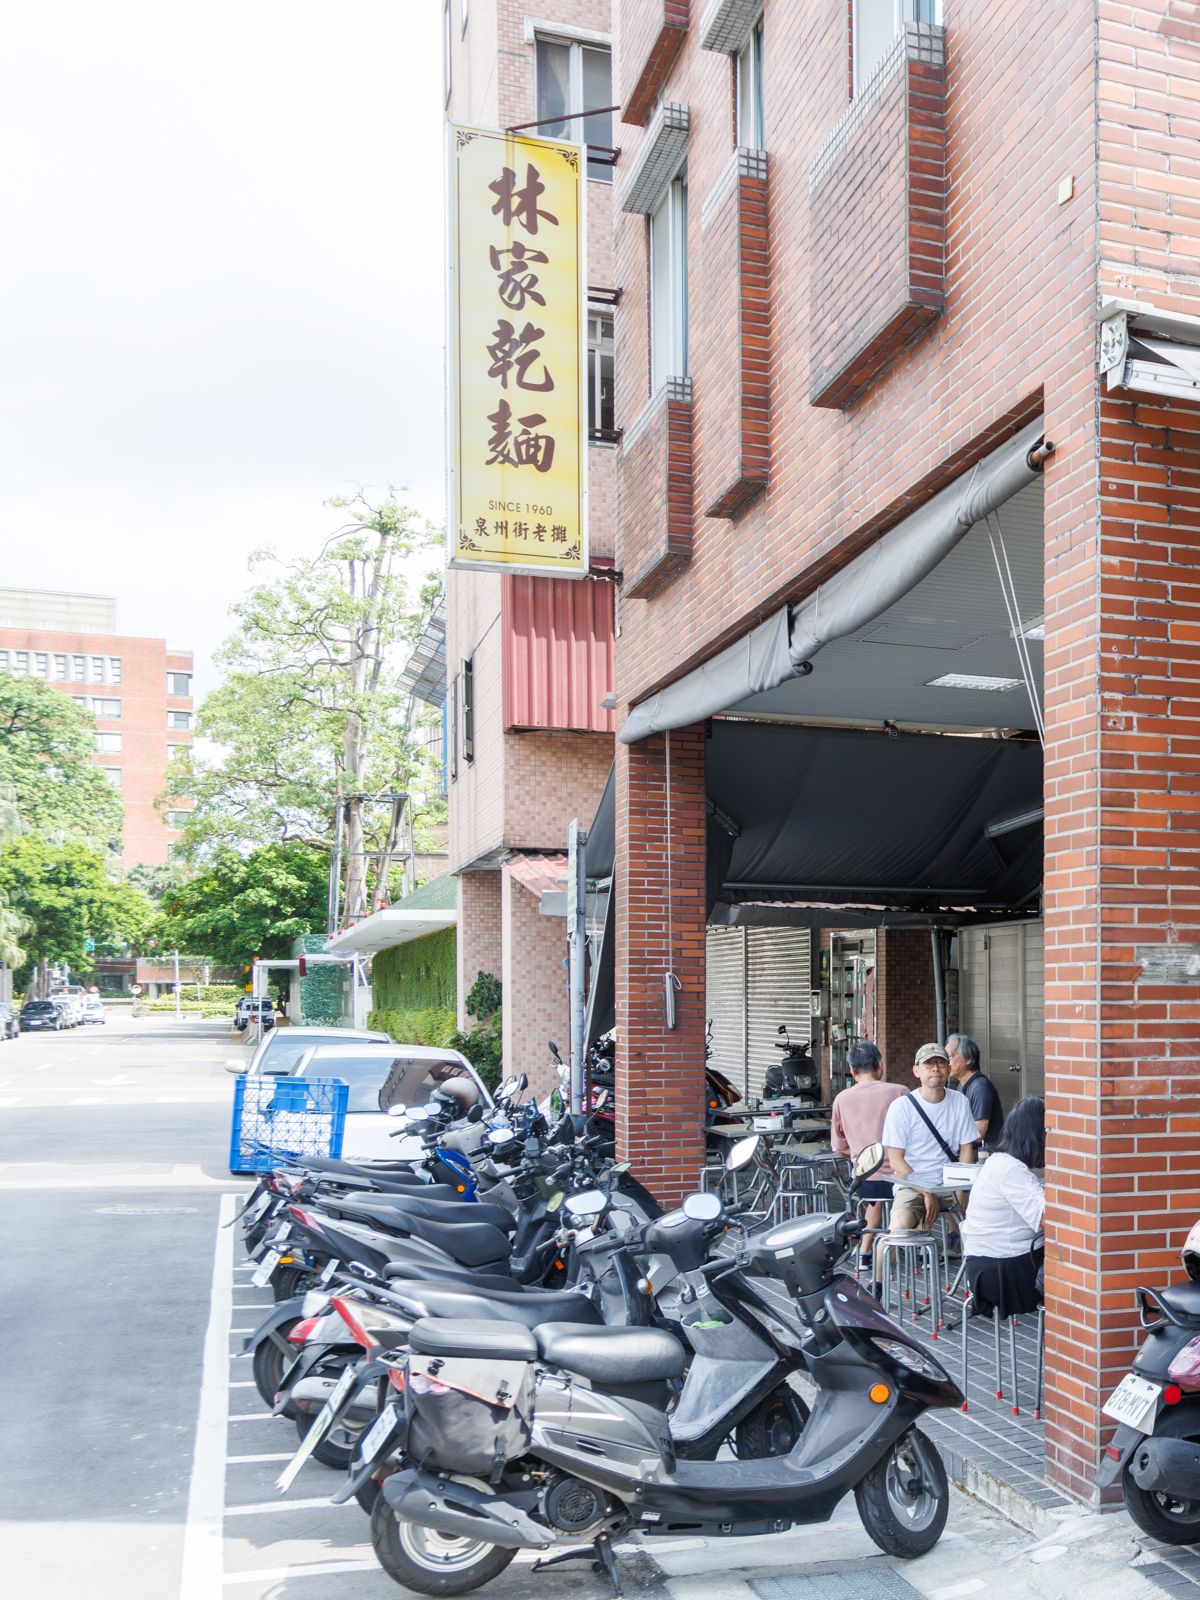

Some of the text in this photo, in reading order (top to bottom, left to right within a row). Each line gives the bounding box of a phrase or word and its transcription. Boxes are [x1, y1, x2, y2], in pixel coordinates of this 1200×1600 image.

[485, 162, 560, 474] 林家乾麵
[488, 499, 553, 516] SINCE 1960
[473, 516, 568, 543] 泉州街老攤
